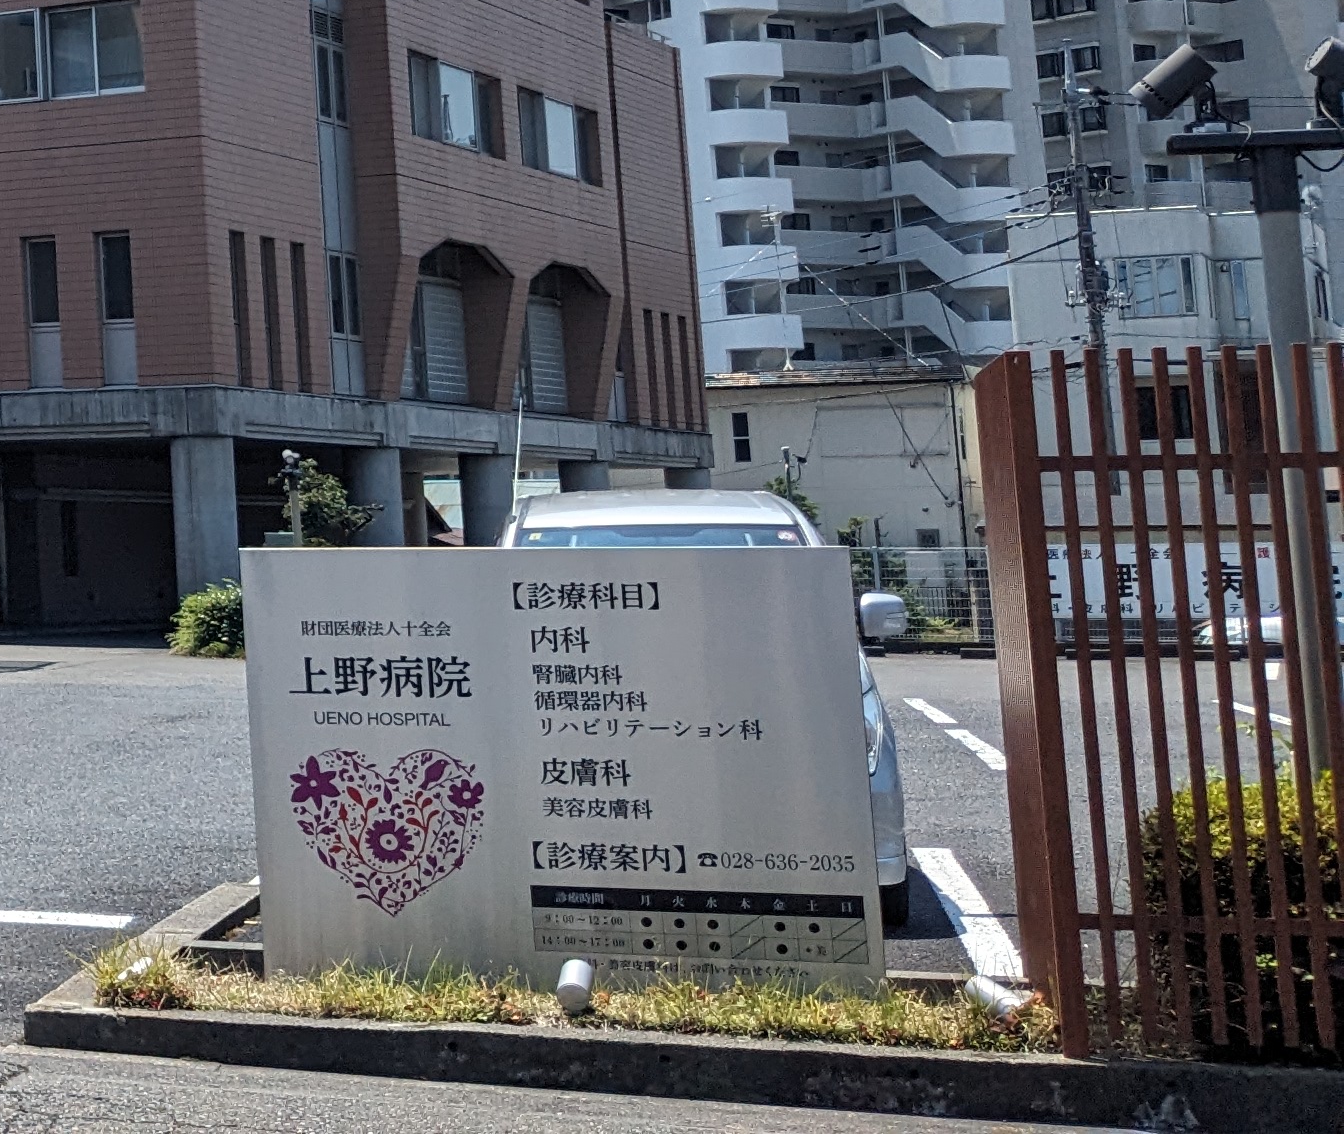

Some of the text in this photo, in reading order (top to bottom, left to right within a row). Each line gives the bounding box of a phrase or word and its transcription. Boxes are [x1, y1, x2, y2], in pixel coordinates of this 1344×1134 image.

[512, 581, 660, 611] 【診療科目】
[300, 619, 451, 638] 財団医療法人十全会
[530, 625, 591, 654] 内科
[289, 655, 473, 699] 上野病院
[532, 664, 623, 686] 腎臓内科
[534, 690, 648, 713] 循環器内科
[314, 710, 451, 728] UENO HOSPITAL
[541, 717, 763, 742] リハビリテーション科
[540, 757, 632, 787] 皮膚科
[542, 796, 654, 820] 美容皮膚科
[532, 840, 855, 873] 【診療案内】 028-636-2035
[640, 894, 651, 907] 月
[672, 895, 685, 908] 火
[705, 896, 718, 909] 水
[740, 897, 751, 910] 木
[772, 898, 785, 912] 金
[806, 899, 819, 912] 土
[841, 901, 852, 913] 日
